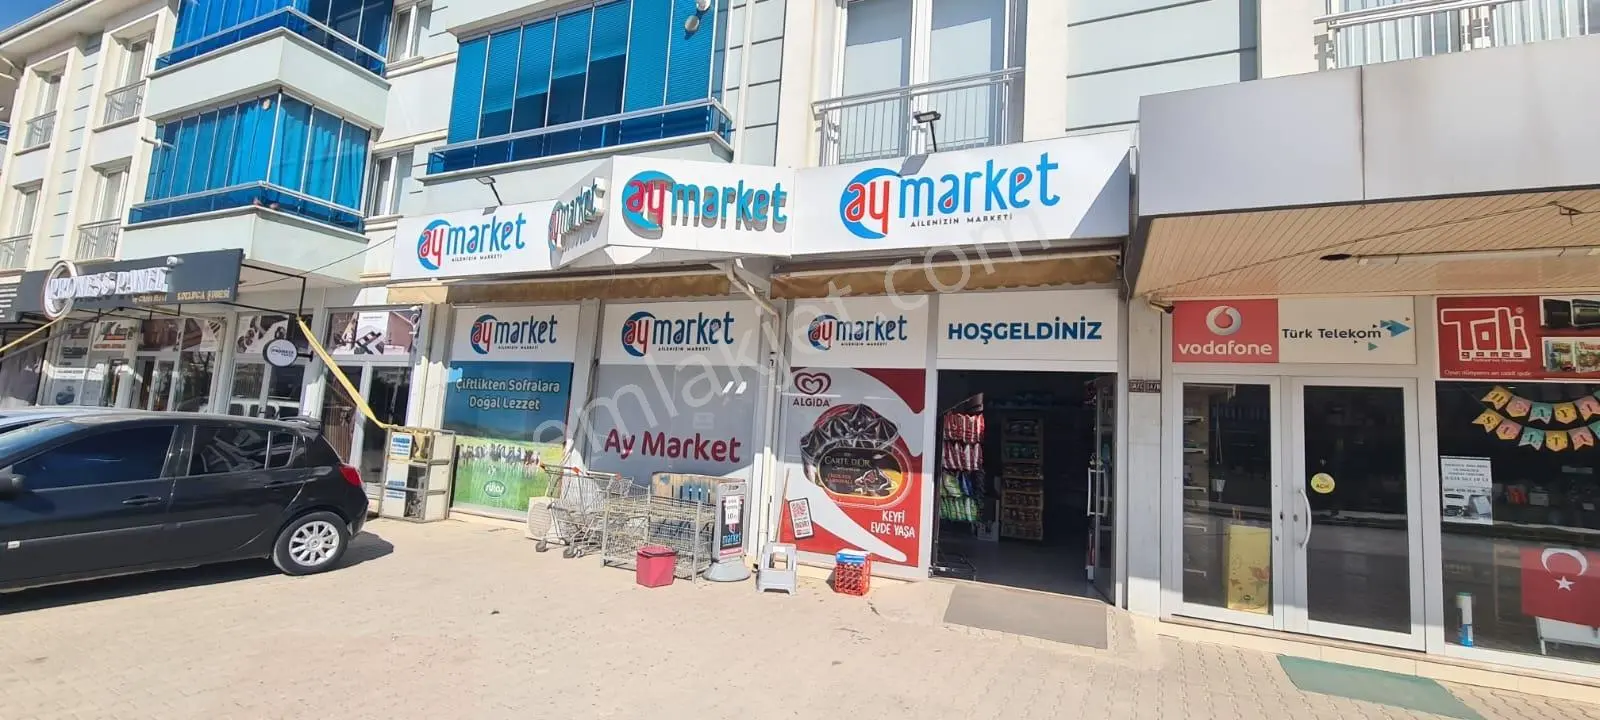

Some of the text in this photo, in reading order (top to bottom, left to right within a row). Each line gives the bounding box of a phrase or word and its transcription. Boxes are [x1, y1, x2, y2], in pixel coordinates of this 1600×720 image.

[966, 212, 1013, 223] MARKETİ
[948, 316, 1103, 345] HOŞGELDİNİZ
[1281, 327, 1382, 339] Türk Telekom
[1178, 340, 1273, 356] vodafone
[456, 377, 560, 393] Çiftlikten Sofralara
[469, 396, 540, 410] Doğal Lezzet
[792, 397, 830, 407] ALGIDA
[604, 429, 741, 463] Ay Market
[881, 510, 906, 523] KEYFİ
[870, 522, 916, 539] EVDE YAŞA
